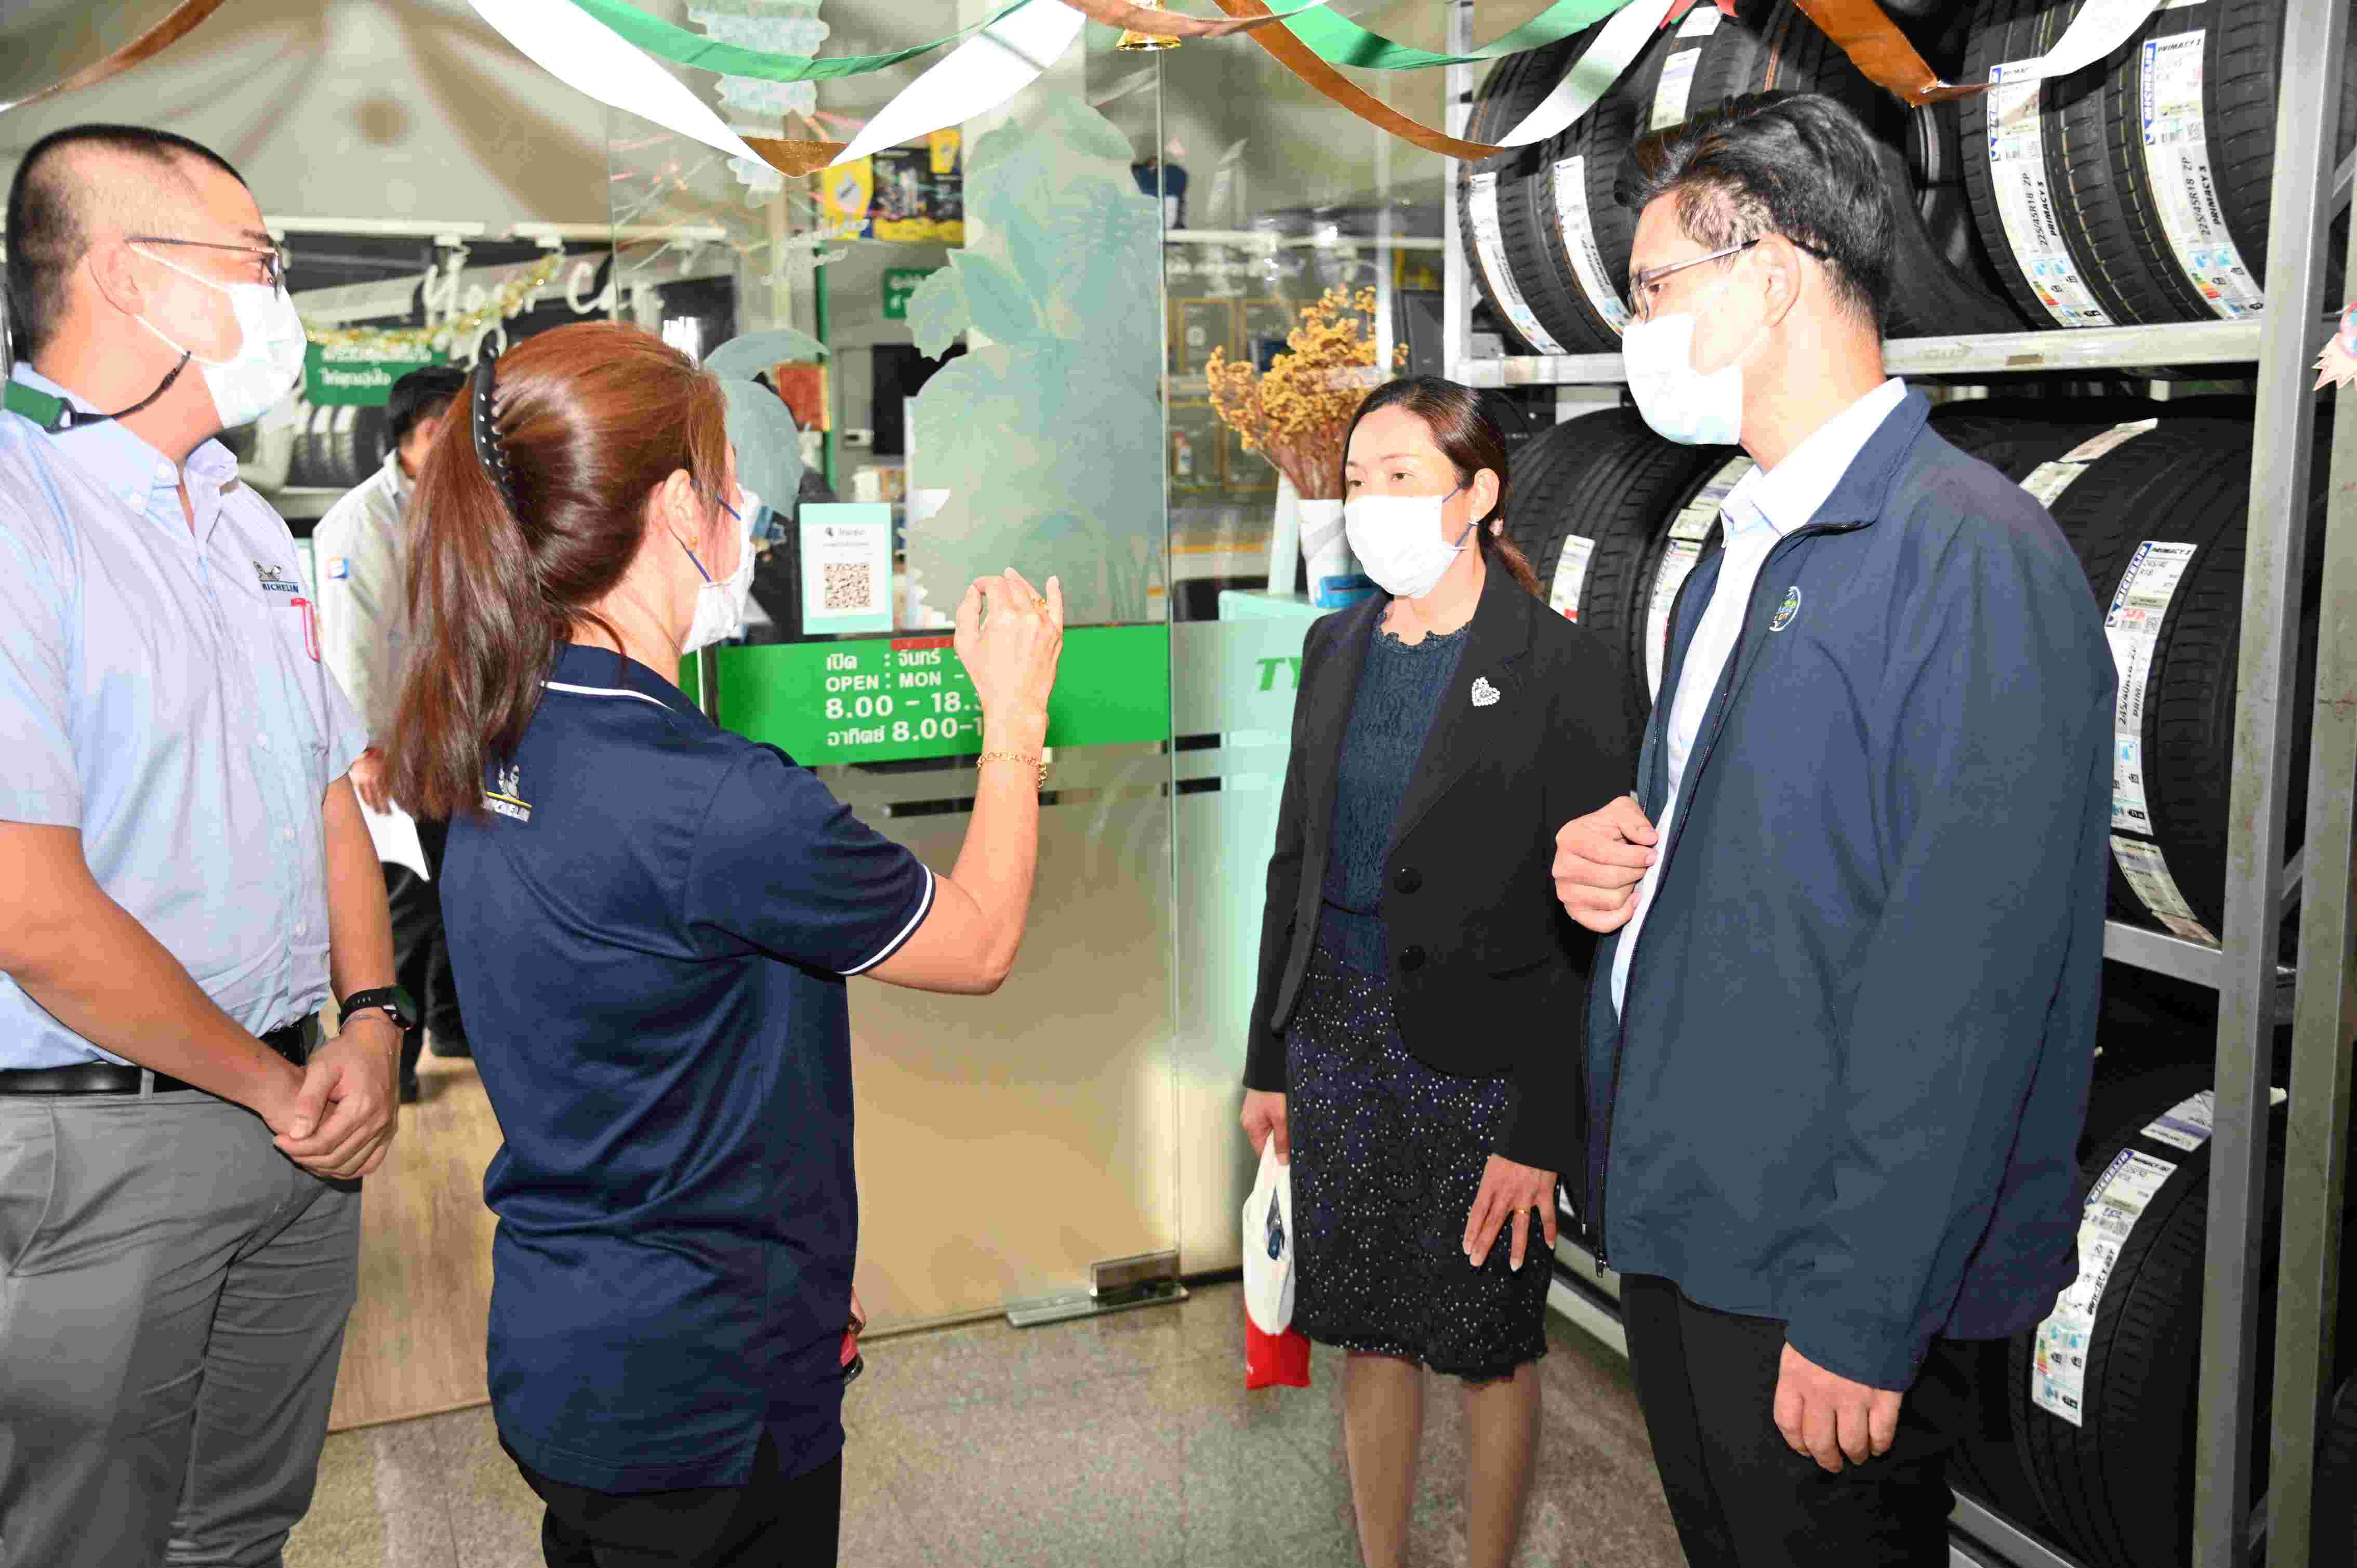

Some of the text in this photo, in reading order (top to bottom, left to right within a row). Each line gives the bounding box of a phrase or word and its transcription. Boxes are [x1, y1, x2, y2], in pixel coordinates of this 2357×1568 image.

[2025, 192, 2048, 246] 225/45R18
[2039, 189, 2058, 236] PRIMACY
[2186, 178, 2212, 235] 225/45R18
[2201, 175, 2221, 225] PRIMACY
[2116, 546, 2148, 604] MICHELIN
[825, 674, 880, 692] OPEN
[898, 671, 942, 689] MON
[826, 652, 857, 671] เปิด
[825, 694, 894, 720] 8.00
[931, 691, 982, 713] 18.
[827, 724, 885, 747] อาทิตย์
